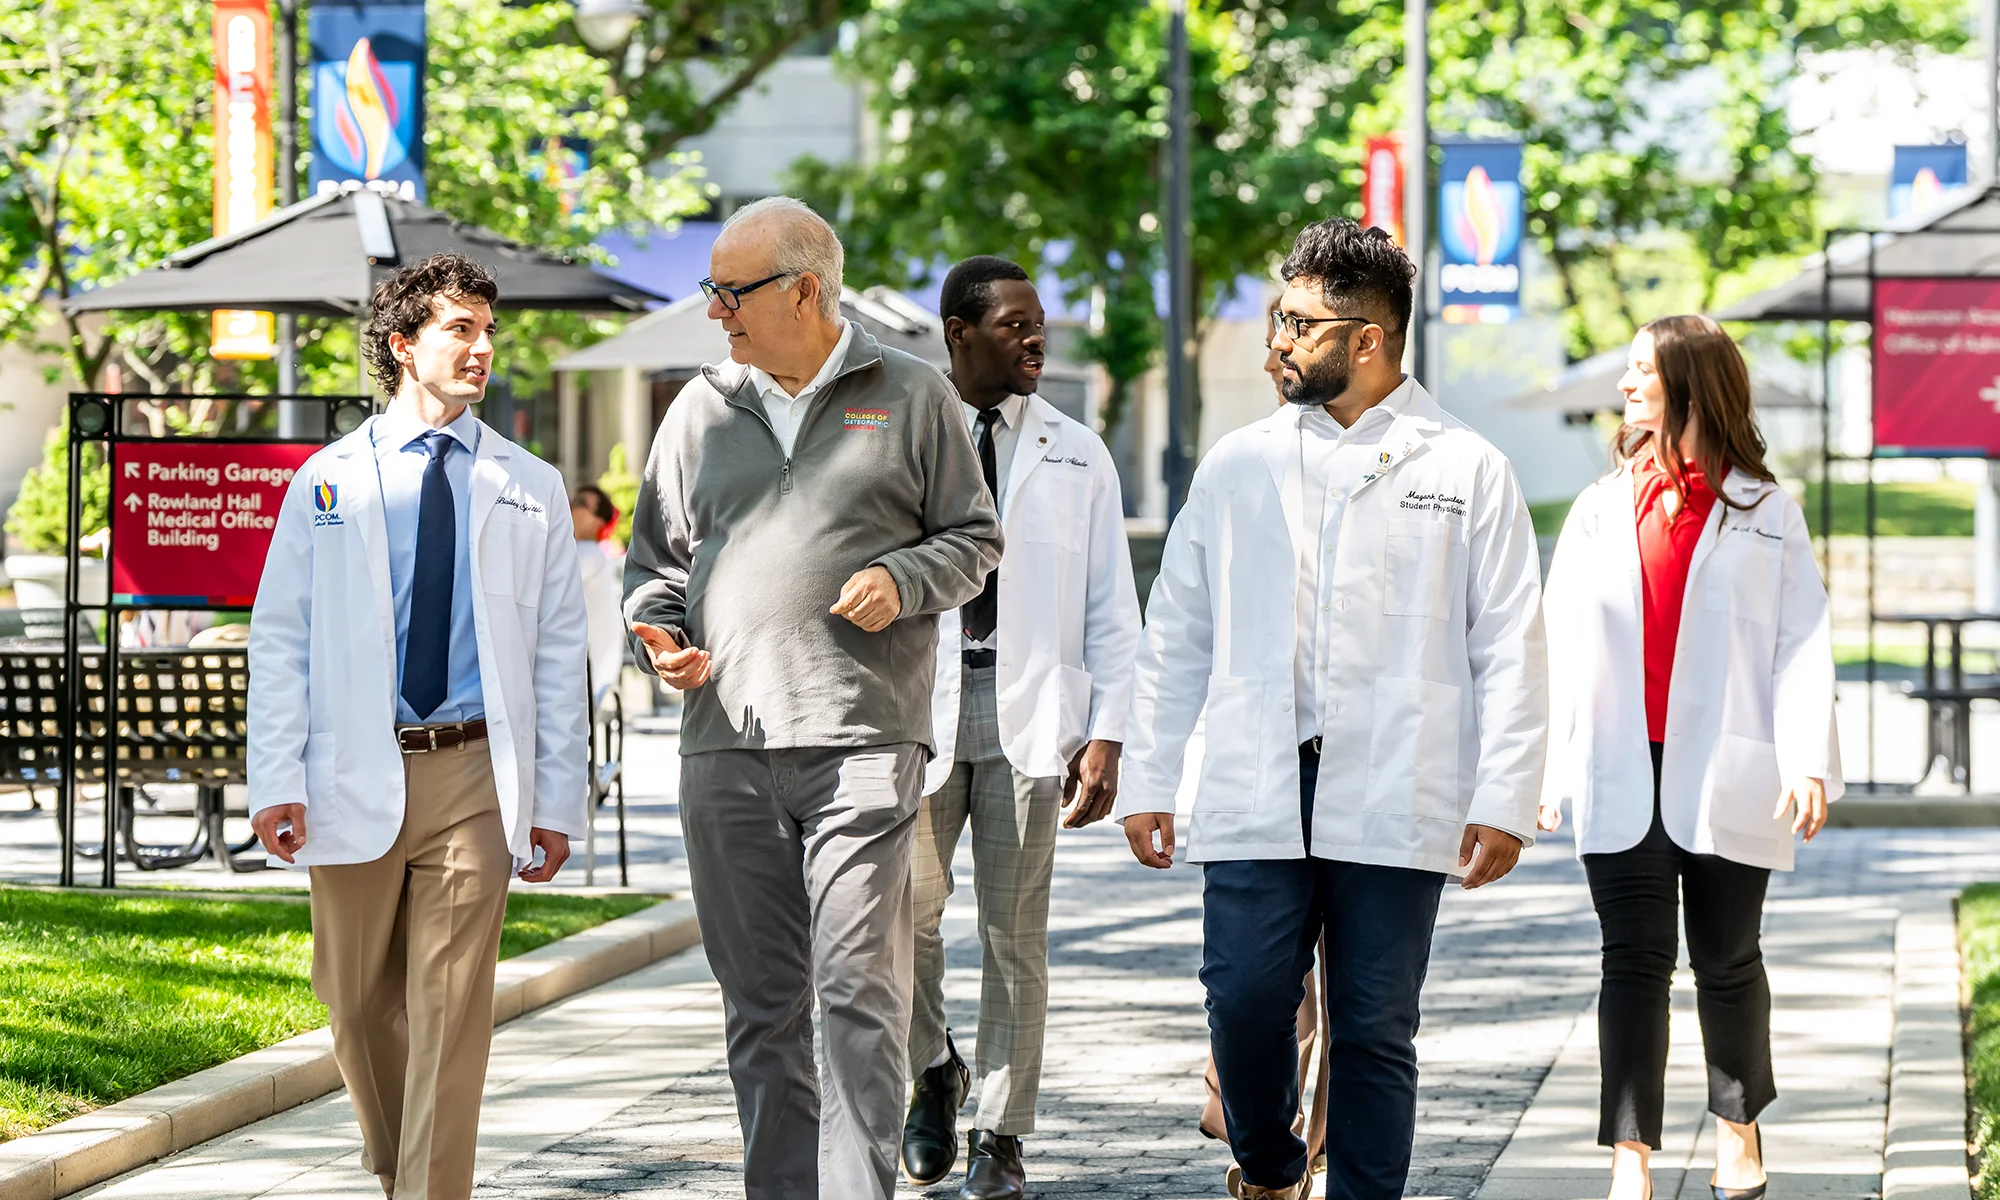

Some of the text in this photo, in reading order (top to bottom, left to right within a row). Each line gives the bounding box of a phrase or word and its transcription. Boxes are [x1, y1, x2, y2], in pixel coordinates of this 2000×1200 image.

[148, 462, 295, 488] Parking Garage
[148, 492, 262, 510] Rowland Hall
[1400, 500, 1467, 517] Student Physician
[147, 510, 275, 530] Medical Office
[147, 529, 220, 551] Building
